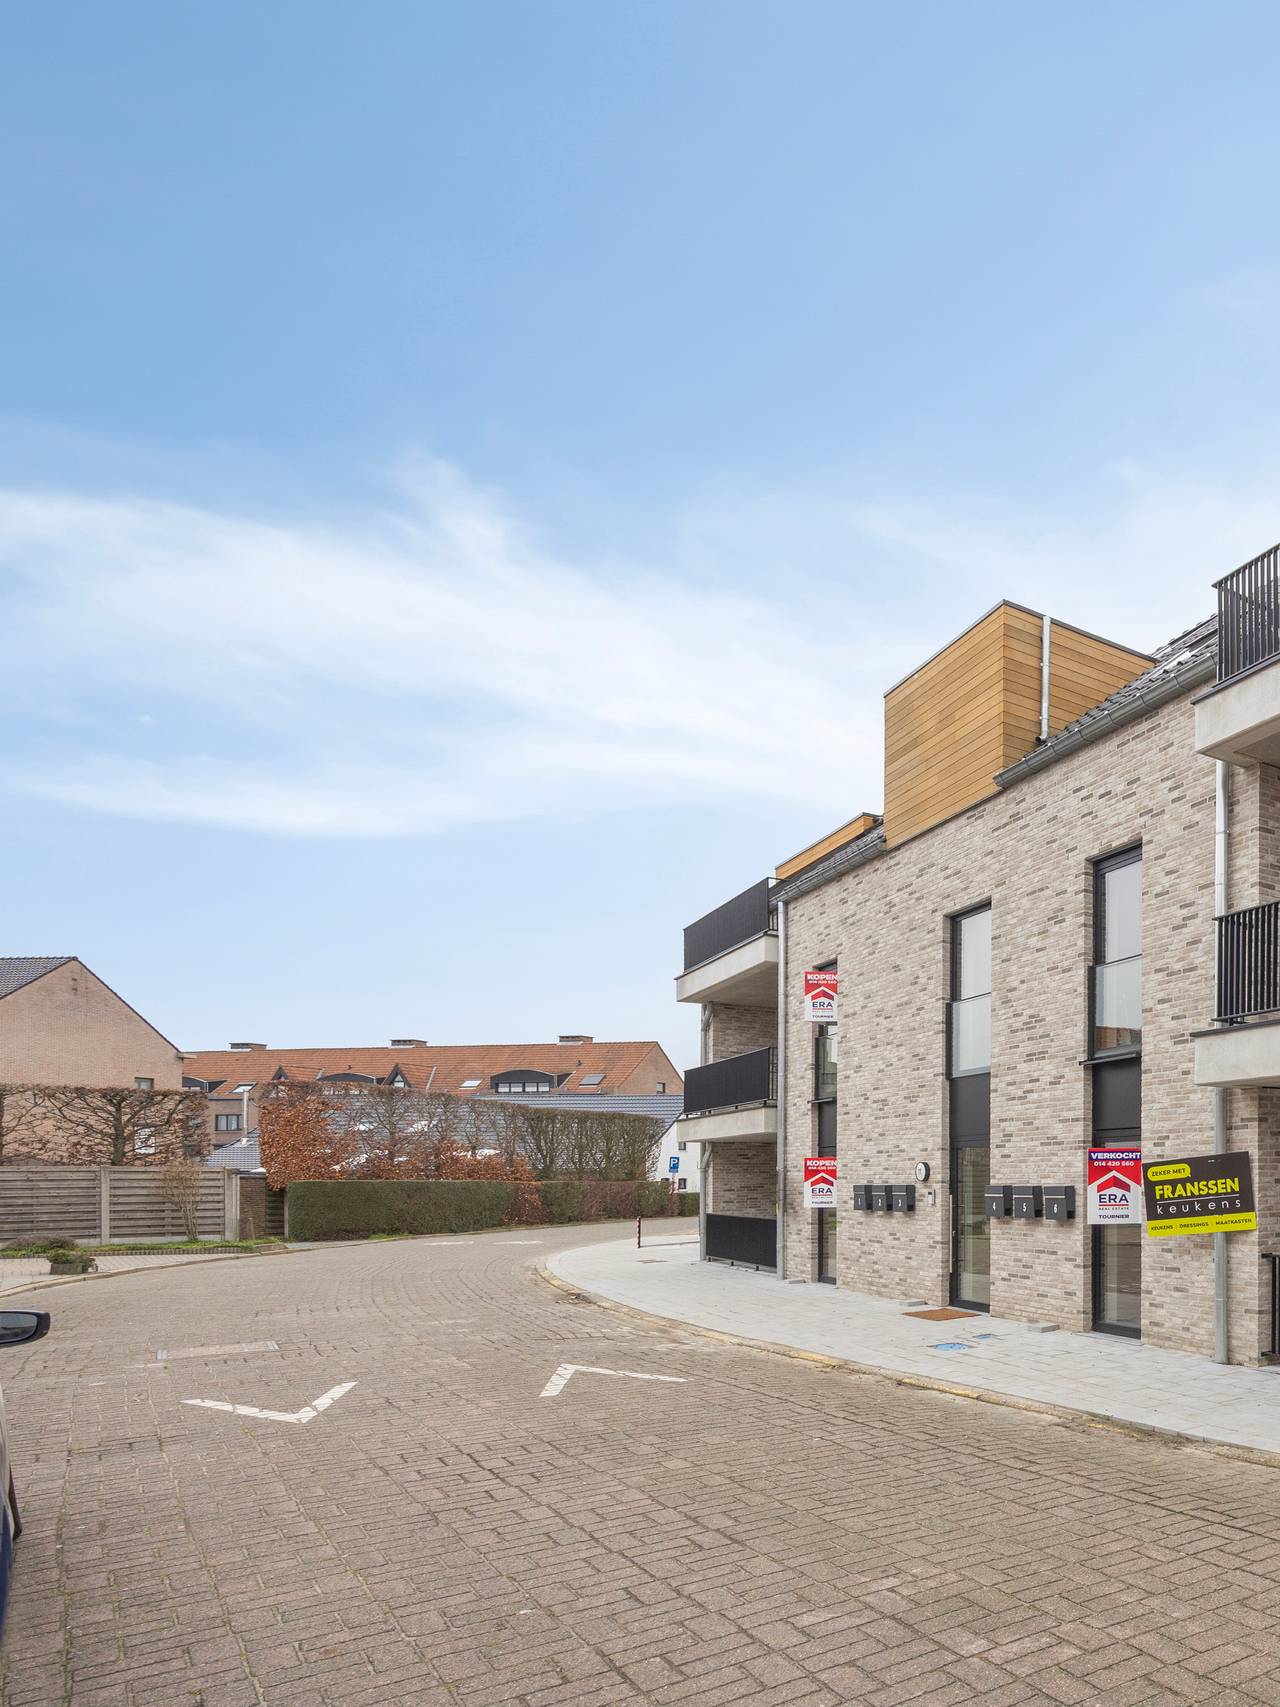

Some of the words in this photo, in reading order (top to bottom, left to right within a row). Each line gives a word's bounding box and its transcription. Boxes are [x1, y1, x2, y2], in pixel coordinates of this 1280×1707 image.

[671, 1158, 678, 1167] P
[1155, 1178, 1240, 1199] FRANSSEN
[1099, 1194, 1129, 1203] ERA
[1023, 1203, 1027, 1212] 5
[1053, 1204, 1058, 1213] 6
[1157, 1200, 1241, 1215] keukens
